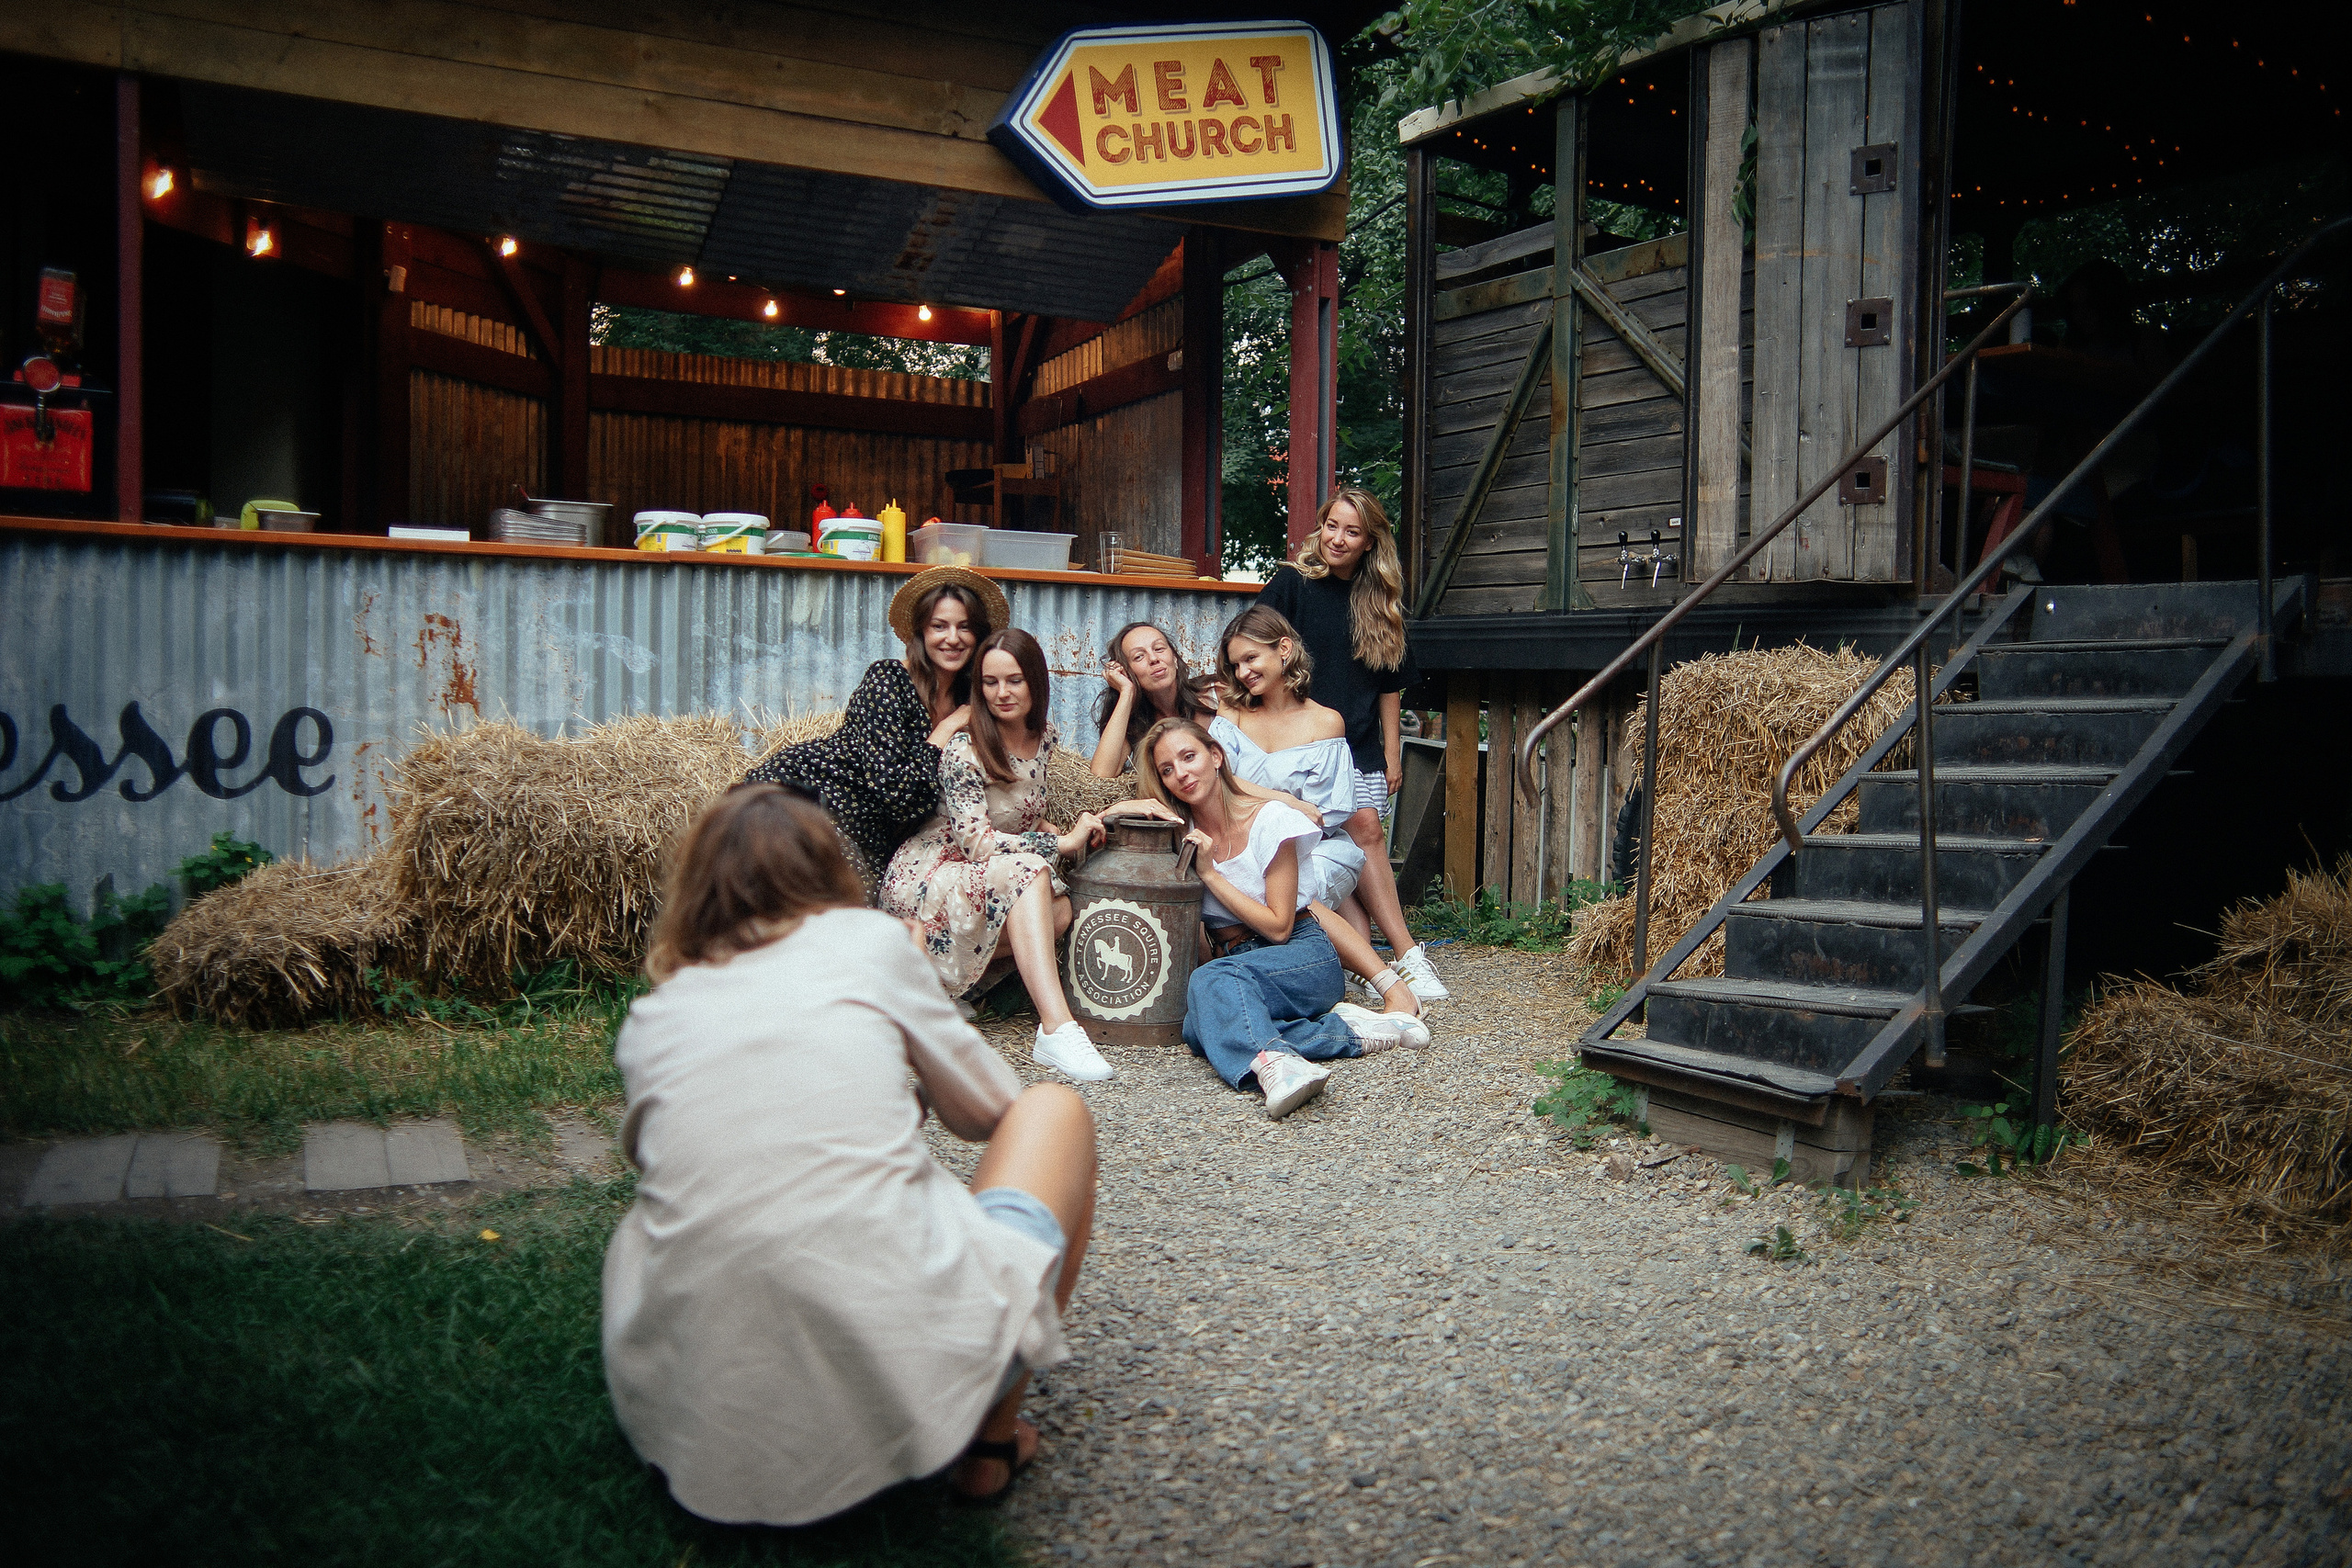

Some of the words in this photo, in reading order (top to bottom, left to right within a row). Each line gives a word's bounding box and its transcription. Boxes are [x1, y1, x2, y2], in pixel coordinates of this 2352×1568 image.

[1088, 55, 1283, 117] MEAT
[1095, 114, 1296, 164] CHURCH
[1076, 913, 1129, 953] TENNESSEE
[1133, 921, 1159, 964] SQUIRE
[1078, 974, 1150, 1005] ASSOCIATION
